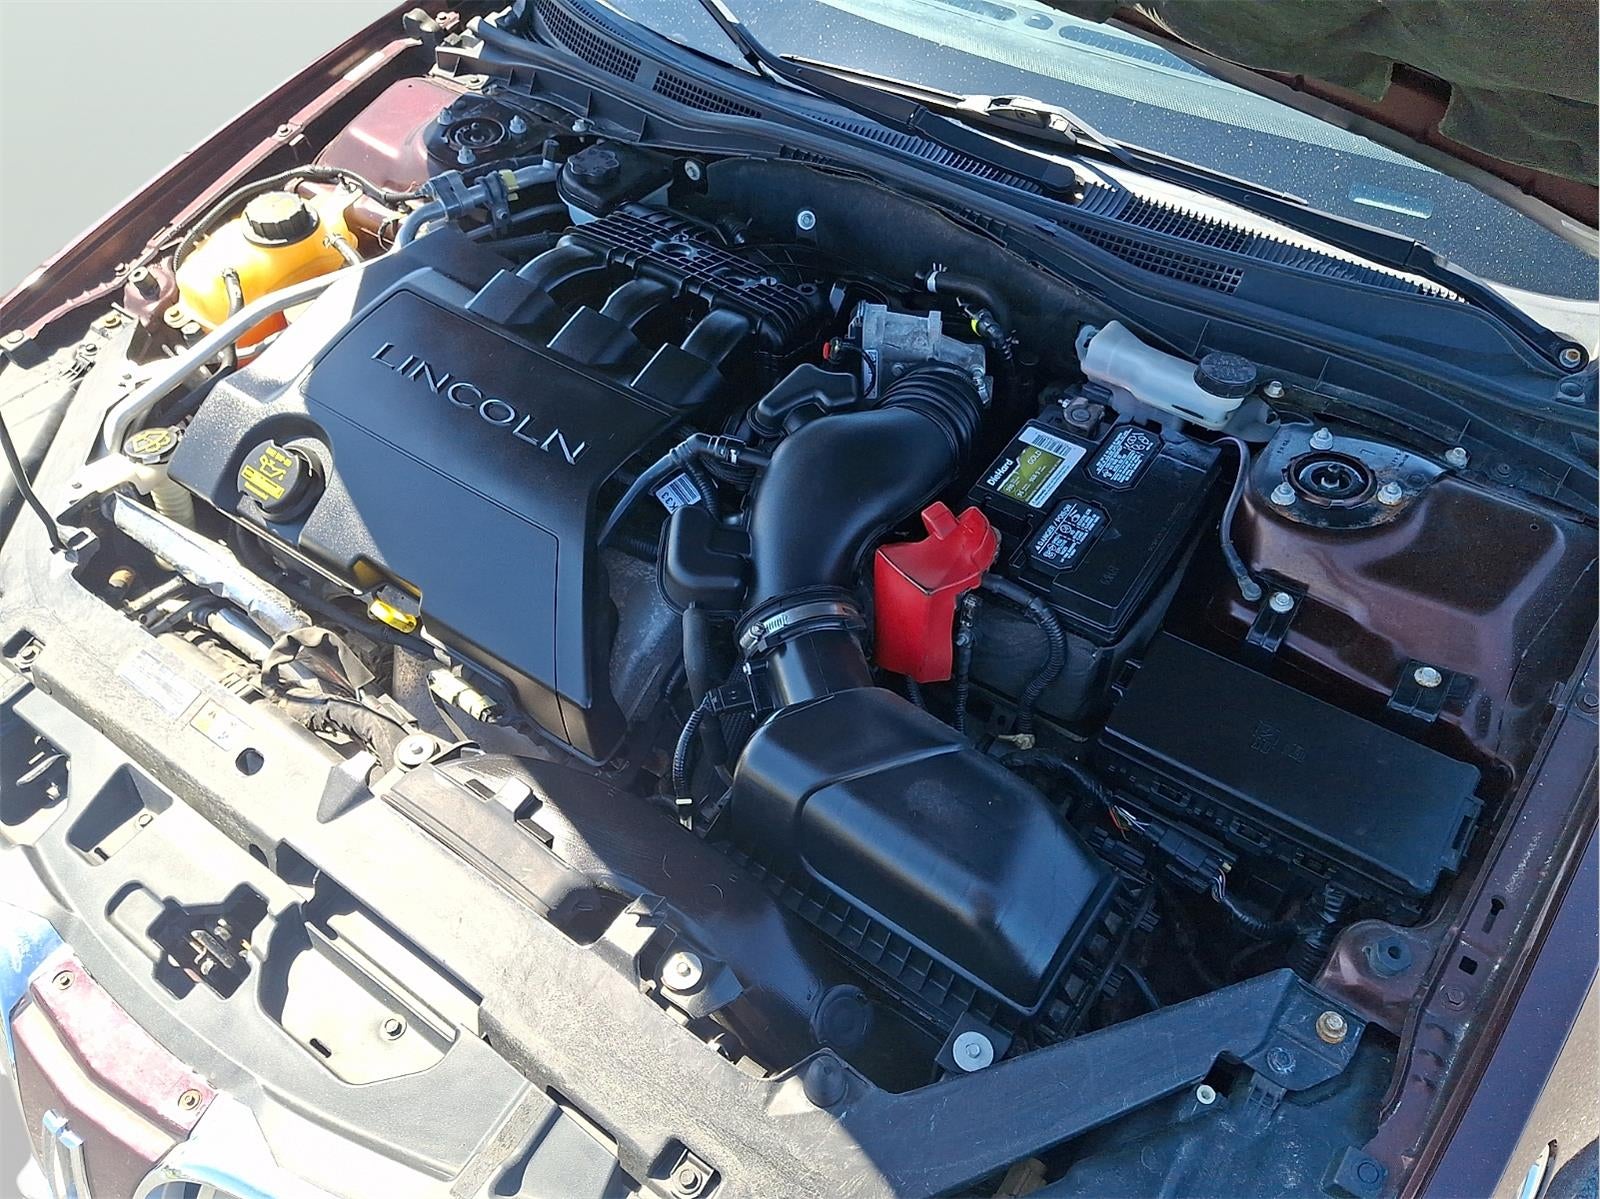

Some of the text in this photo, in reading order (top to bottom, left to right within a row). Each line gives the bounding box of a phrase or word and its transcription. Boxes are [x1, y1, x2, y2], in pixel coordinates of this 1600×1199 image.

[370, 341, 589, 466] LINCOLN
[1027, 450, 1042, 465] GOLD
[986, 458, 1014, 486] DieHard
[661, 492, 678, 511] K33
